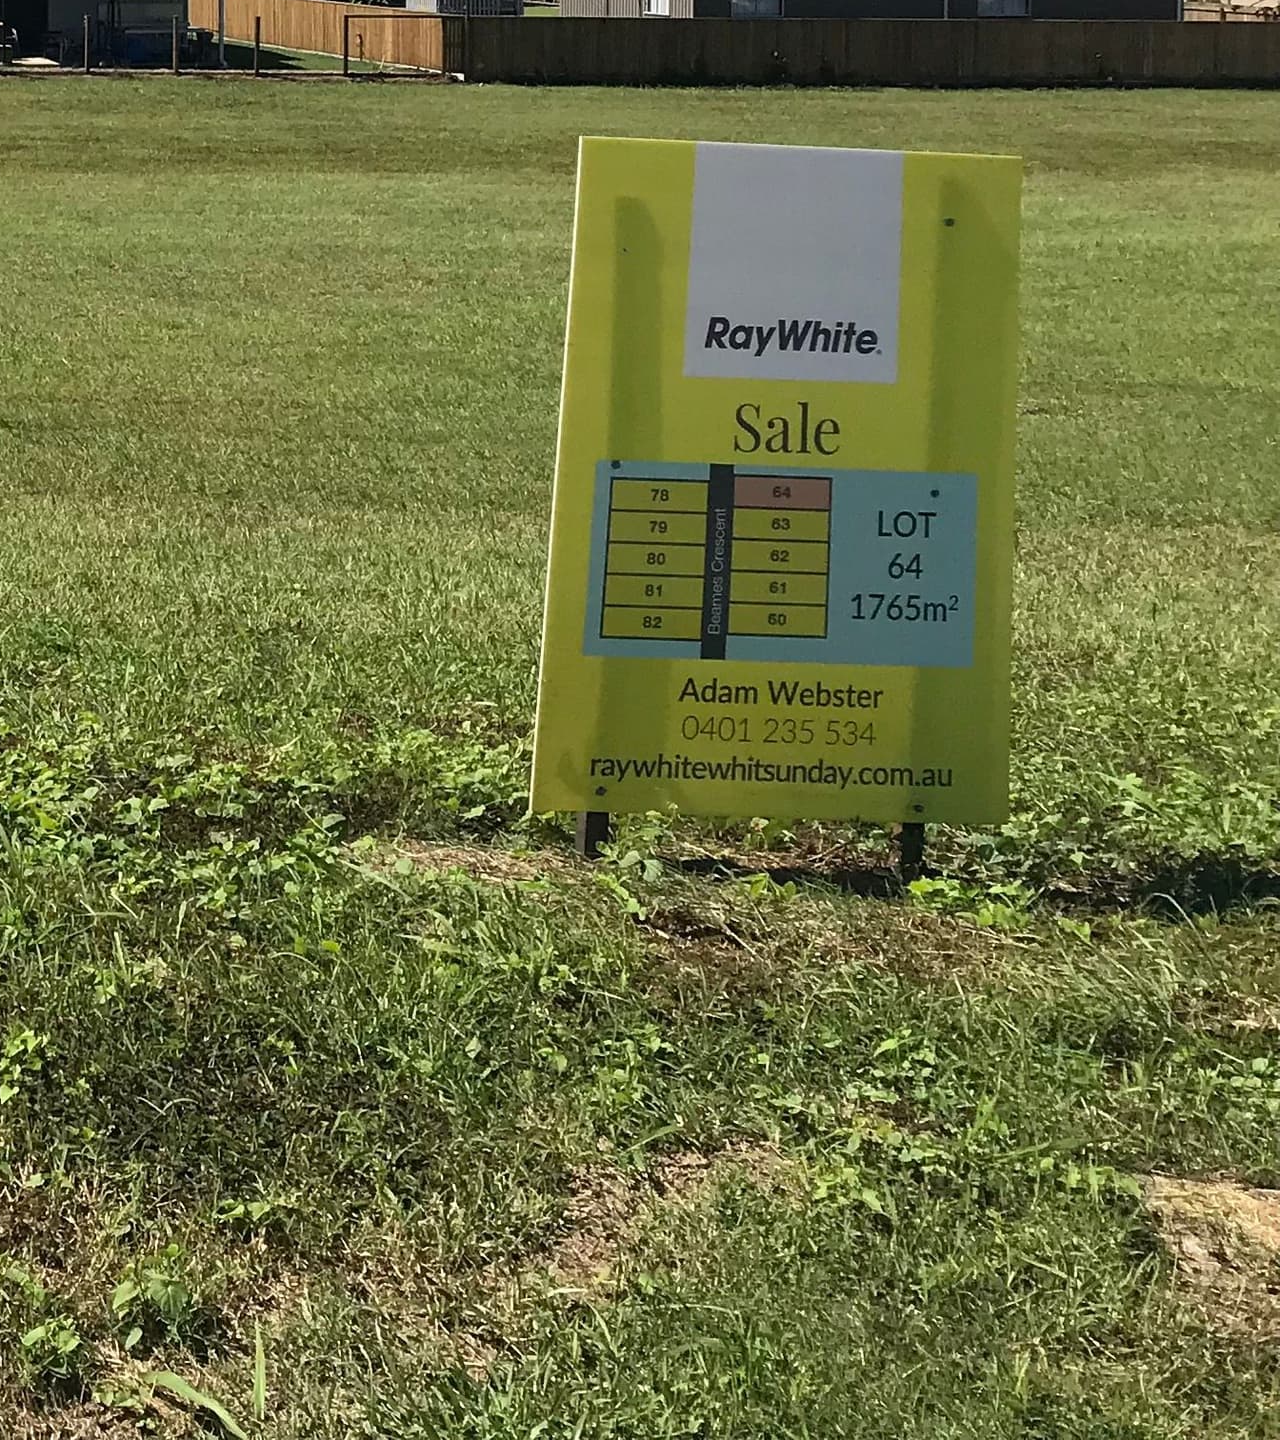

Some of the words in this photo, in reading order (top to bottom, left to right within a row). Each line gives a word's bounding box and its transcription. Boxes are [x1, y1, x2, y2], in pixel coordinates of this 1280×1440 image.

[704, 316, 879, 357] RayWhite
[733, 401, 841, 455] Sale
[650, 488, 670, 502] 78
[772, 486, 792, 499] 64
[649, 520, 668, 534] 79
[771, 517, 791, 531] 63
[878, 510, 937, 538] LOT
[710, 508, 728, 573] Crescent
[646, 552, 666, 566] 80
[770, 549, 790, 563] 62
[888, 552, 923, 580] 64
[644, 584, 663, 598] 81
[769, 581, 788, 595] 61
[707, 576, 724, 635] Beames
[850, 593, 960, 622] 1765m²
[642, 616, 663, 629] 82
[767, 613, 788, 626] 60
[678, 677, 759, 705] Adam
[767, 679, 884, 709] Webster
[681, 715, 753, 743] 0401
[762, 717, 815, 745] 235
[824, 719, 877, 746] 534
[590, 752, 953, 790] raywhitewhitsunday.com.au
